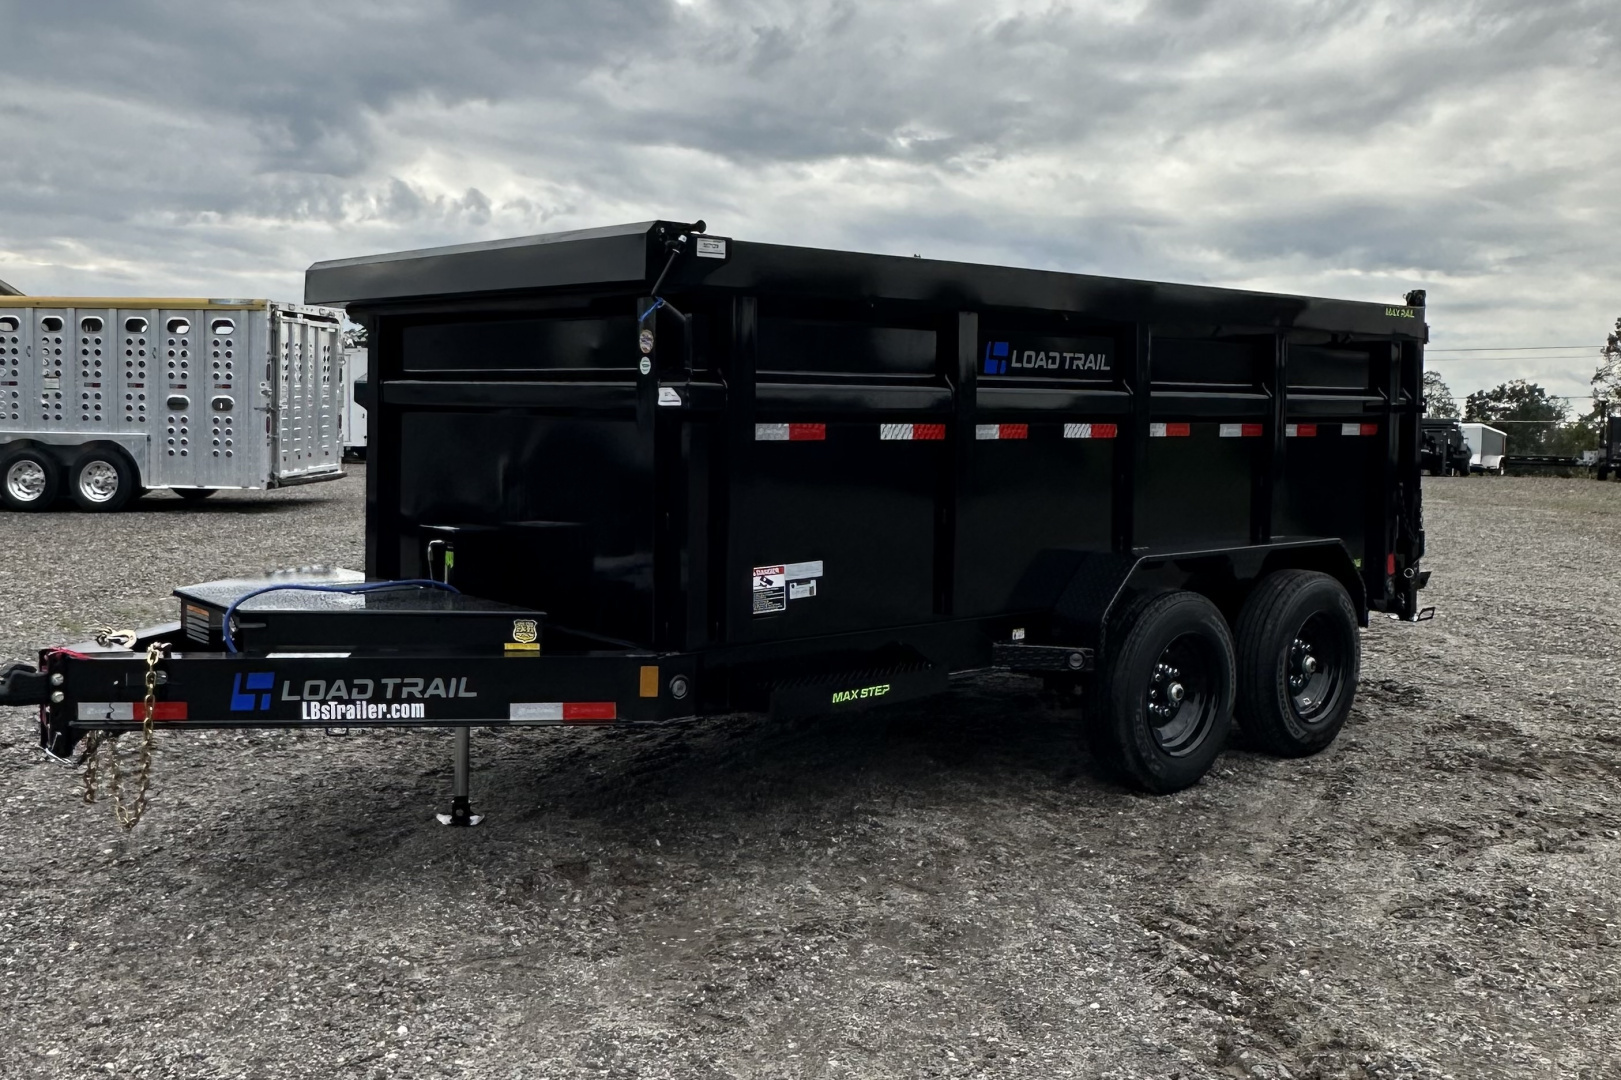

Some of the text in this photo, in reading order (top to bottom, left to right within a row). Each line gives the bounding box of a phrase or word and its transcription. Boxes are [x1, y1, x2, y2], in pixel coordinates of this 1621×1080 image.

[1011, 350, 1111, 371] LOAD TRAIL
[281, 677, 478, 701] LOAD TRAIL
[832, 684, 890, 703] MAX STEP
[302, 701, 425, 720] LBsTrailer.com
